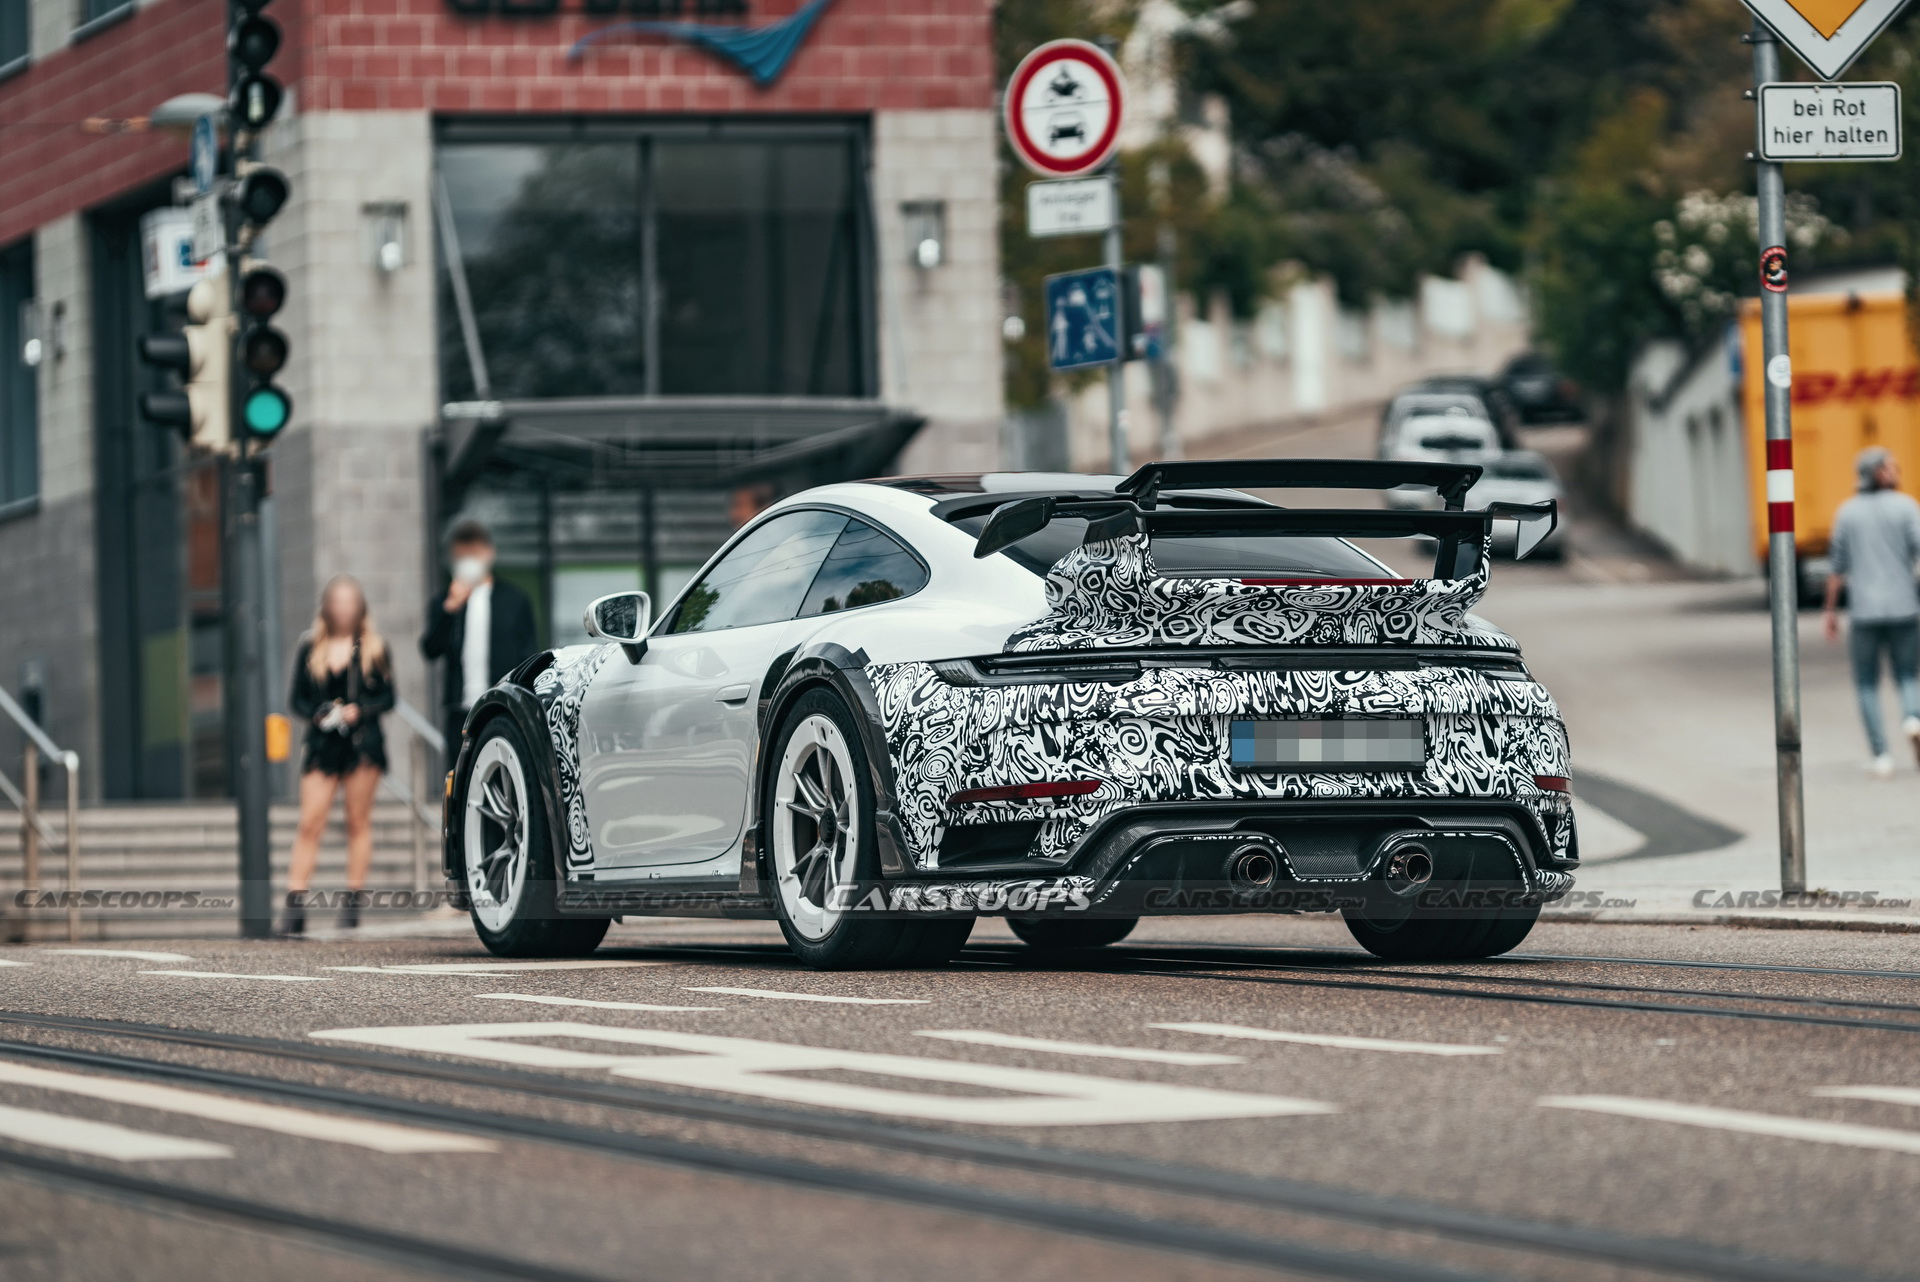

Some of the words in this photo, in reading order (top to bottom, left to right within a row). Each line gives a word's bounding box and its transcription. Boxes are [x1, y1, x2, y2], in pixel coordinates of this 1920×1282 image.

[1793, 99, 1823, 116] bei
[1833, 99, 1866, 116] Rot
[1774, 126, 1813, 143] hier
[1825, 126, 1888, 143] halten
